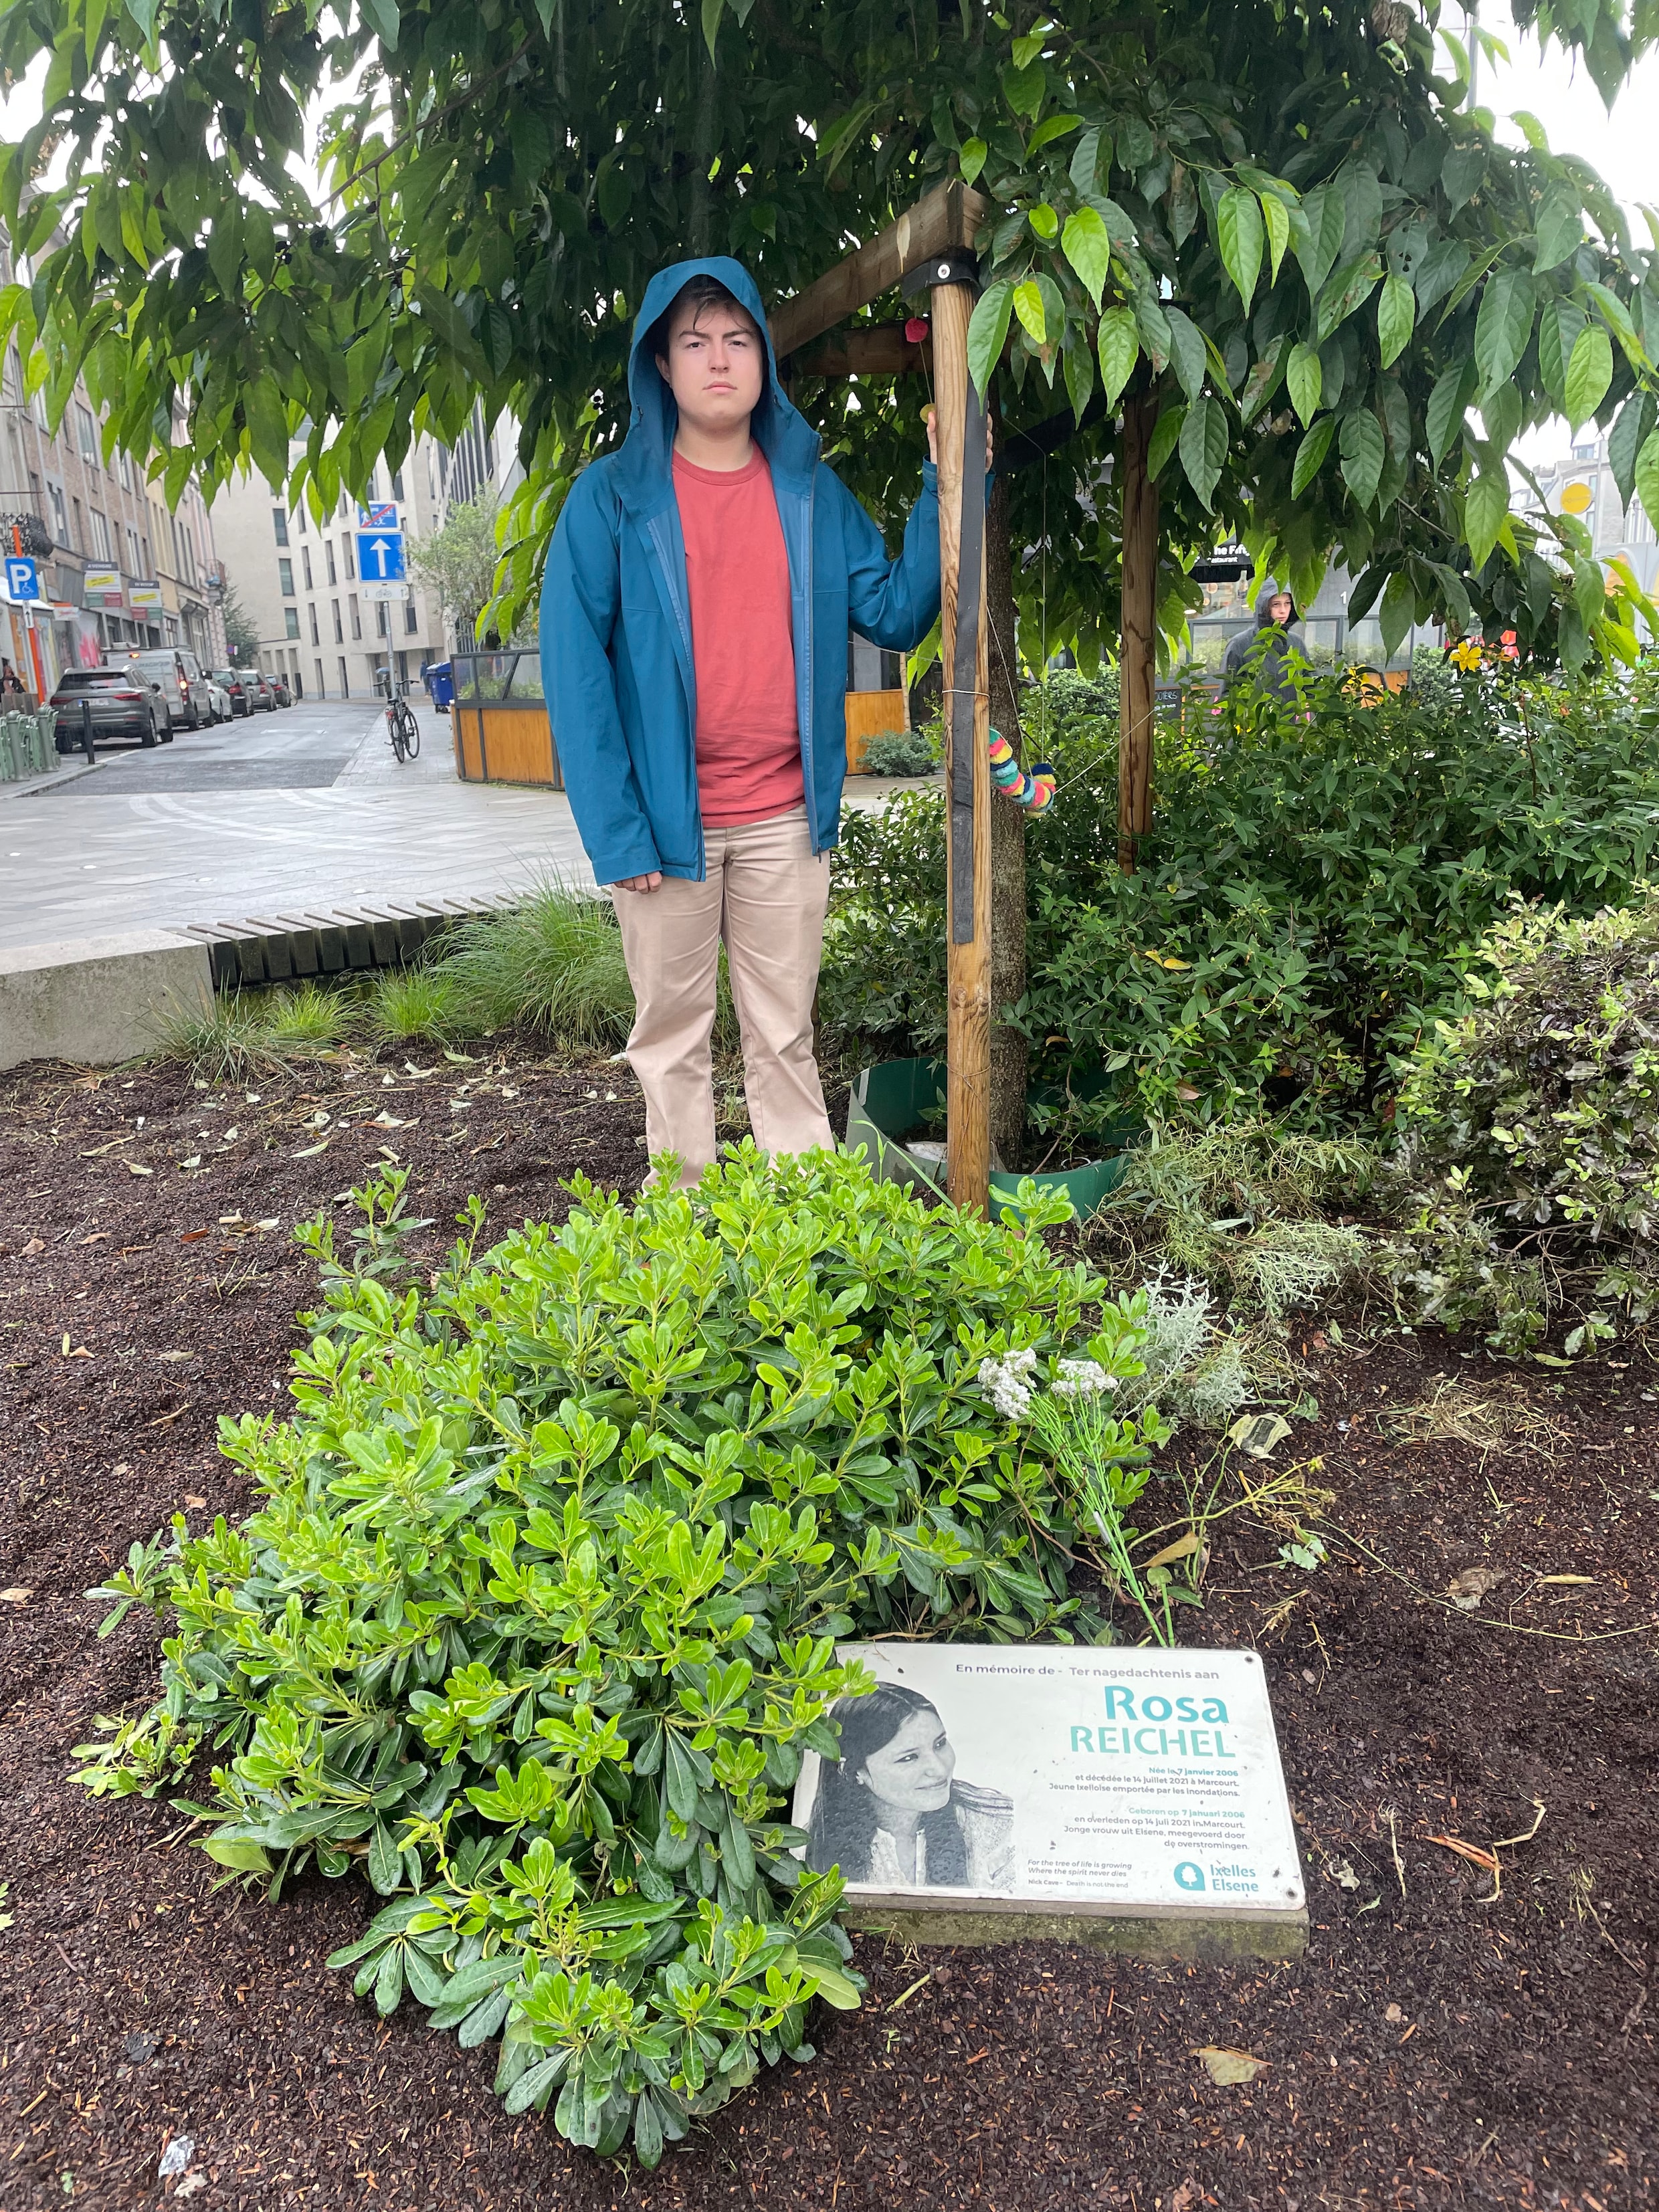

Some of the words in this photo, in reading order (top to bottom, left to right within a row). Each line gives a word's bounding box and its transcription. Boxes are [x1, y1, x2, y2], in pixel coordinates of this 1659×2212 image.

[1213, 546, 1228, 555] he
[1229, 544, 1250, 557] Fift
[10, 565, 32, 594] P
[956, 1664, 973, 1673] En
[976, 1665, 1036, 1675] mémoire
[1038, 1666, 1055, 1675] de
[1069, 1667, 1090, 1676] Ter
[1093, 1668, 1191, 1679] nagedachtenis
[1195, 1671, 1219, 1680] aan
[1104, 1686, 1230, 1724] Rosa
[1070, 1726, 1236, 1758] REICHEL
[1184, 1768, 1214, 1776] janvier
[1085, 1774, 1122, 1782] décédée
[1143, 1777, 1167, 1785] juillet
[1186, 1788, 1240, 1797] inondations.
[1155, 1818, 1169, 1827] juli
[1203, 1821, 1246, 1829] Marcourt.
[1064, 1826, 1090, 1834] Jonge
[1136, 1828, 1167, 1836] Elsene,
[1177, 1841, 1250, 1851] overstromingen.
[1210, 1864, 1256, 1878] Ixelles
[1212, 1879, 1259, 1892] Elsene
